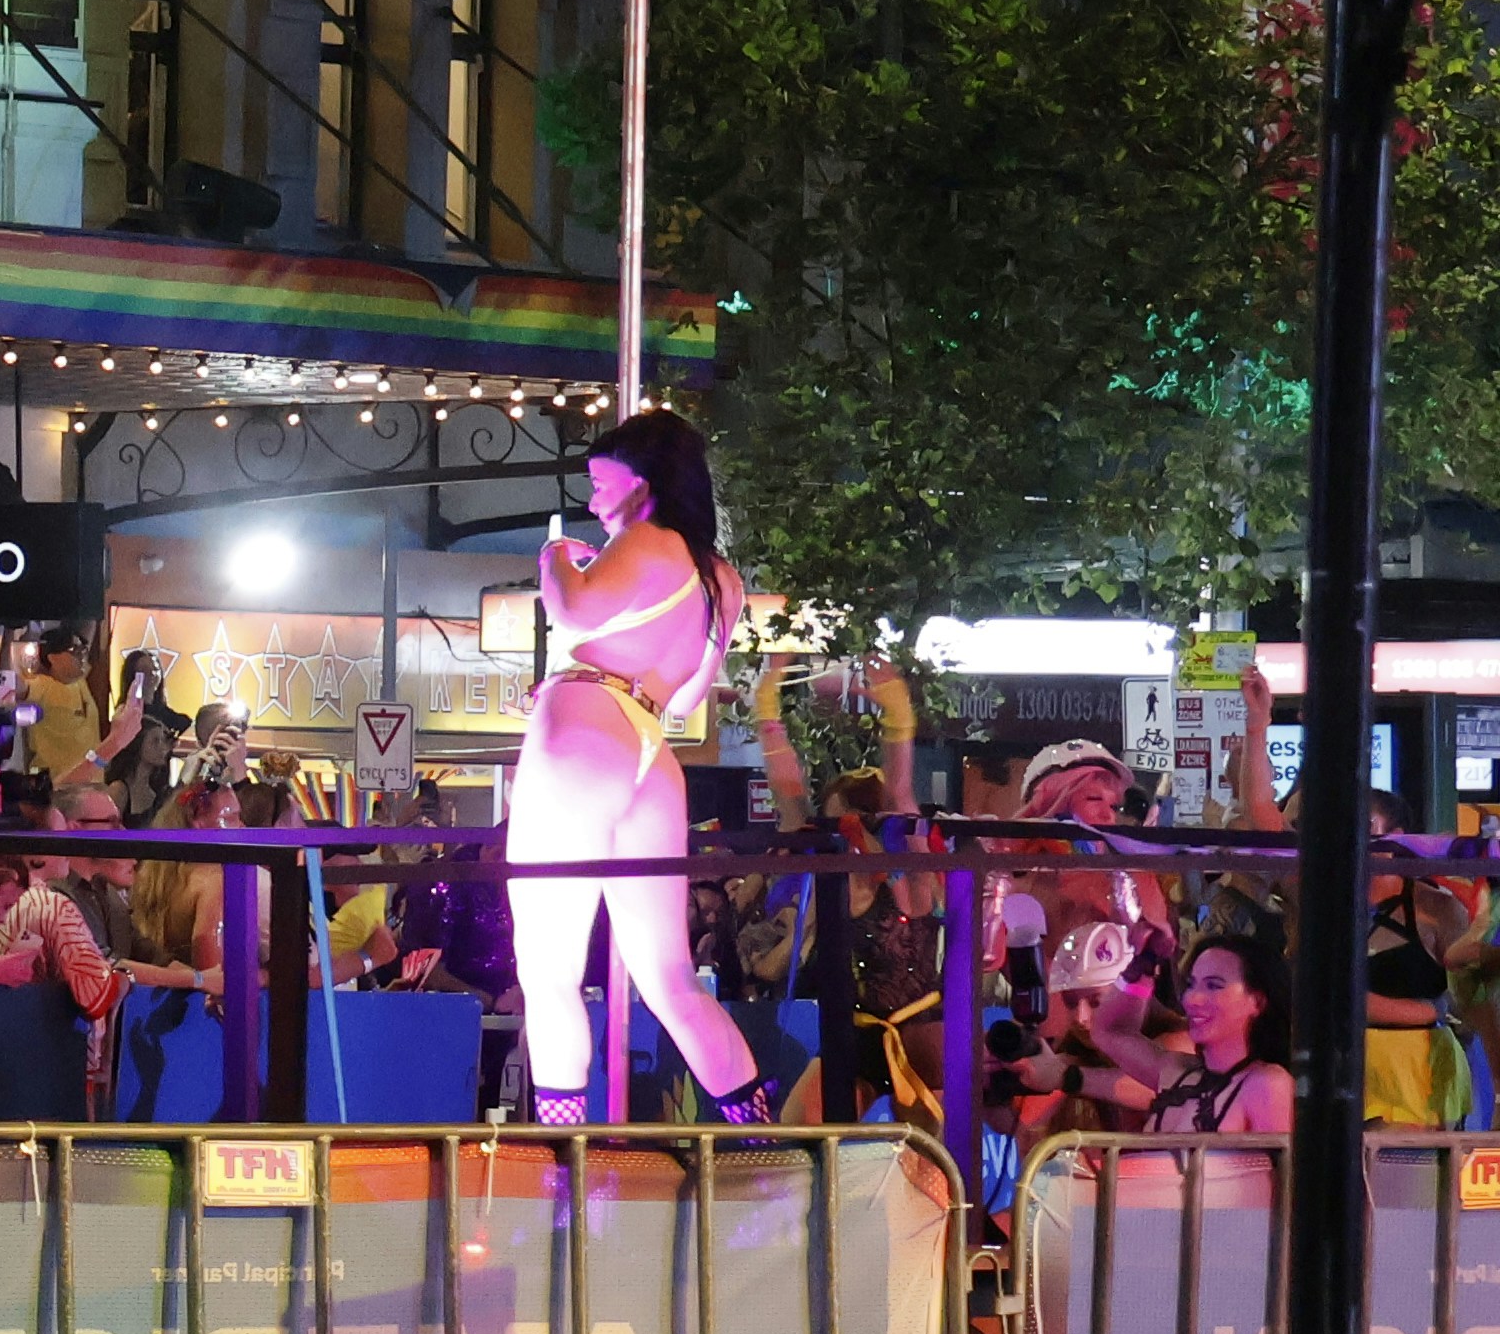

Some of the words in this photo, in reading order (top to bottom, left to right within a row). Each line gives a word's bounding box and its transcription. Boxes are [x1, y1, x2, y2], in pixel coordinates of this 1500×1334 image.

[430, 649, 520, 713] KEB
[1215, 697, 1247, 708] OTHE
[1136, 754, 1168, 769] END
[216, 1147, 293, 1180] TFH
[1471, 1155, 1500, 1185] TF
